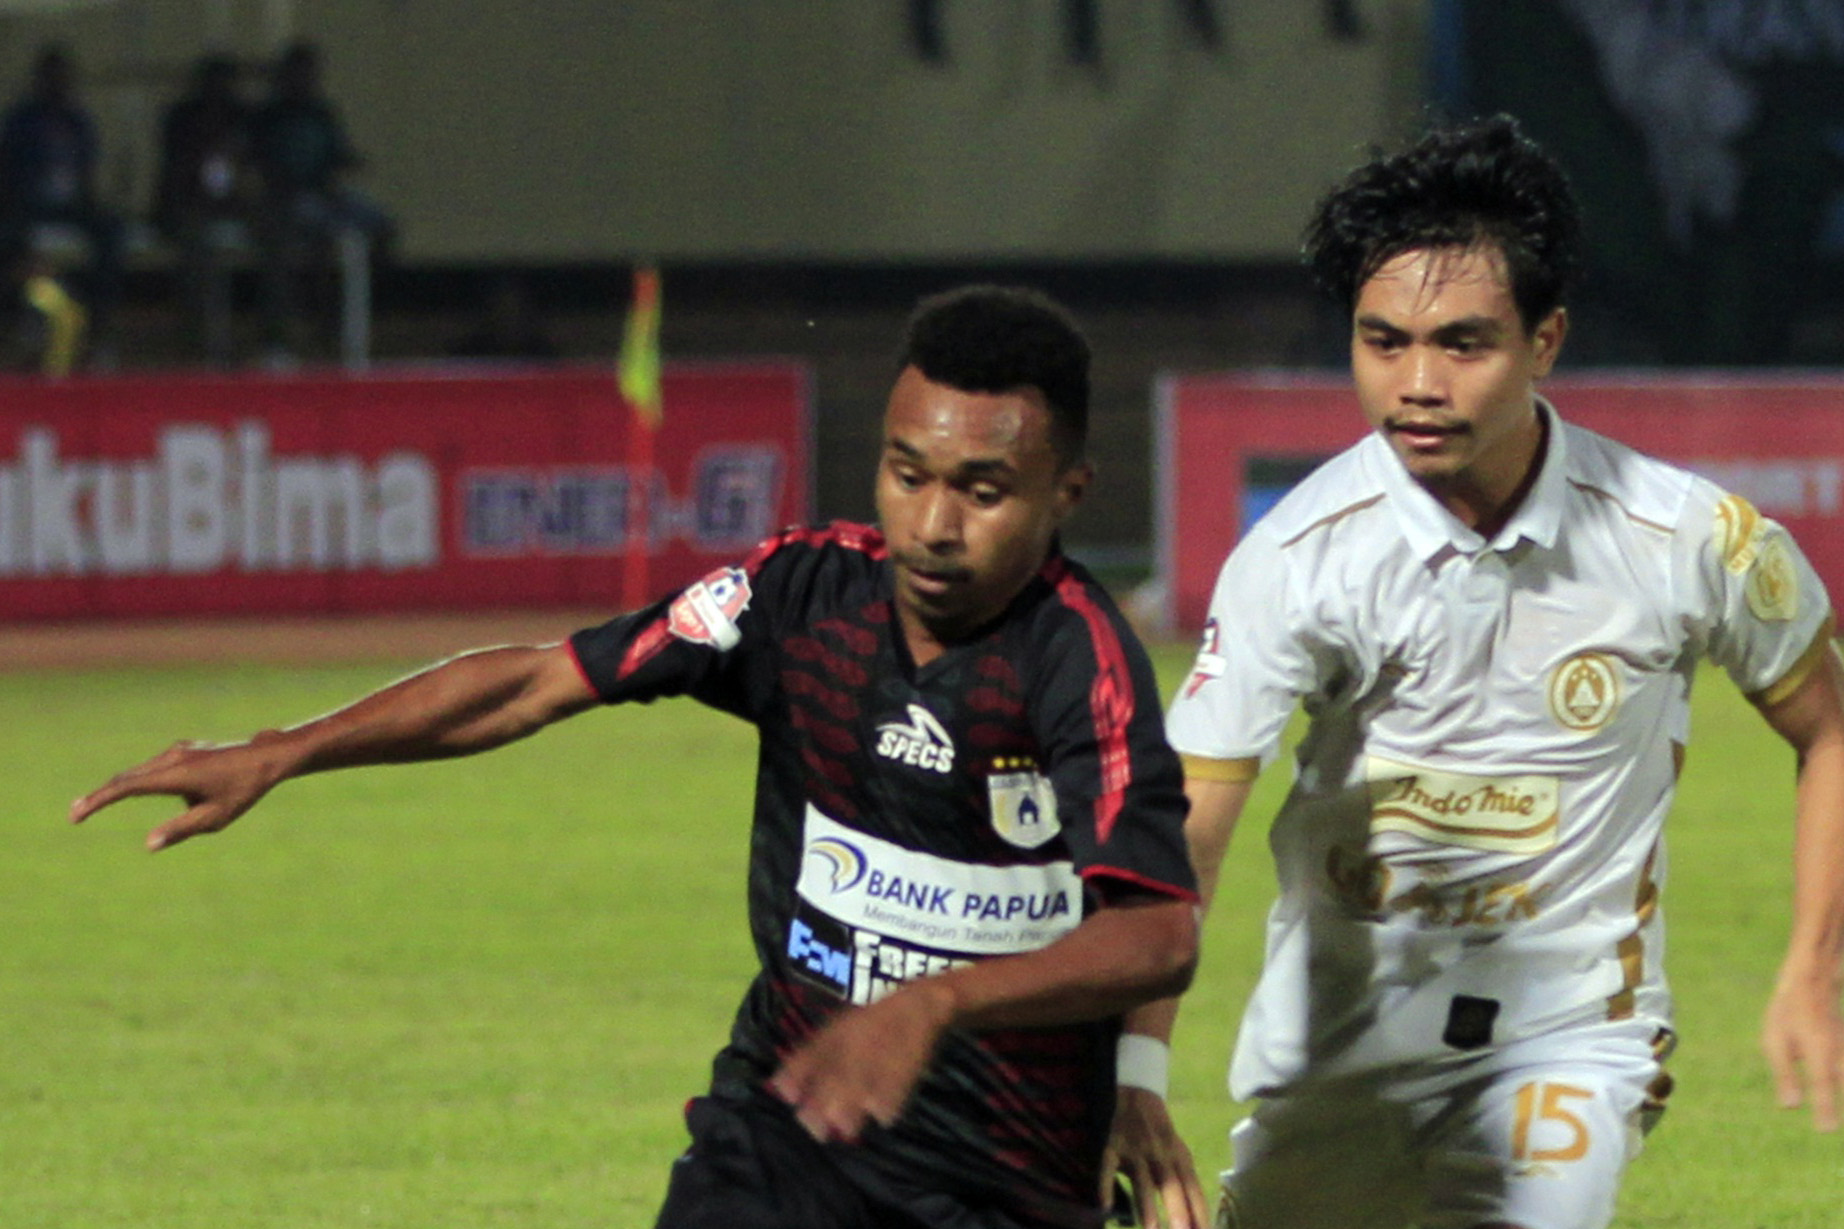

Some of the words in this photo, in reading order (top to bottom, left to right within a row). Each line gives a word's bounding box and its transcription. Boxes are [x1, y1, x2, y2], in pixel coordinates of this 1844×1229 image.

[0, 420, 442, 577] kuBima
[876, 730, 955, 774] SPECS
[862, 902, 958, 940] Membangun
[865, 868, 956, 916] BANK
[960, 890, 1071, 922] PAPUA
[1512, 1081, 1595, 1162] 15
